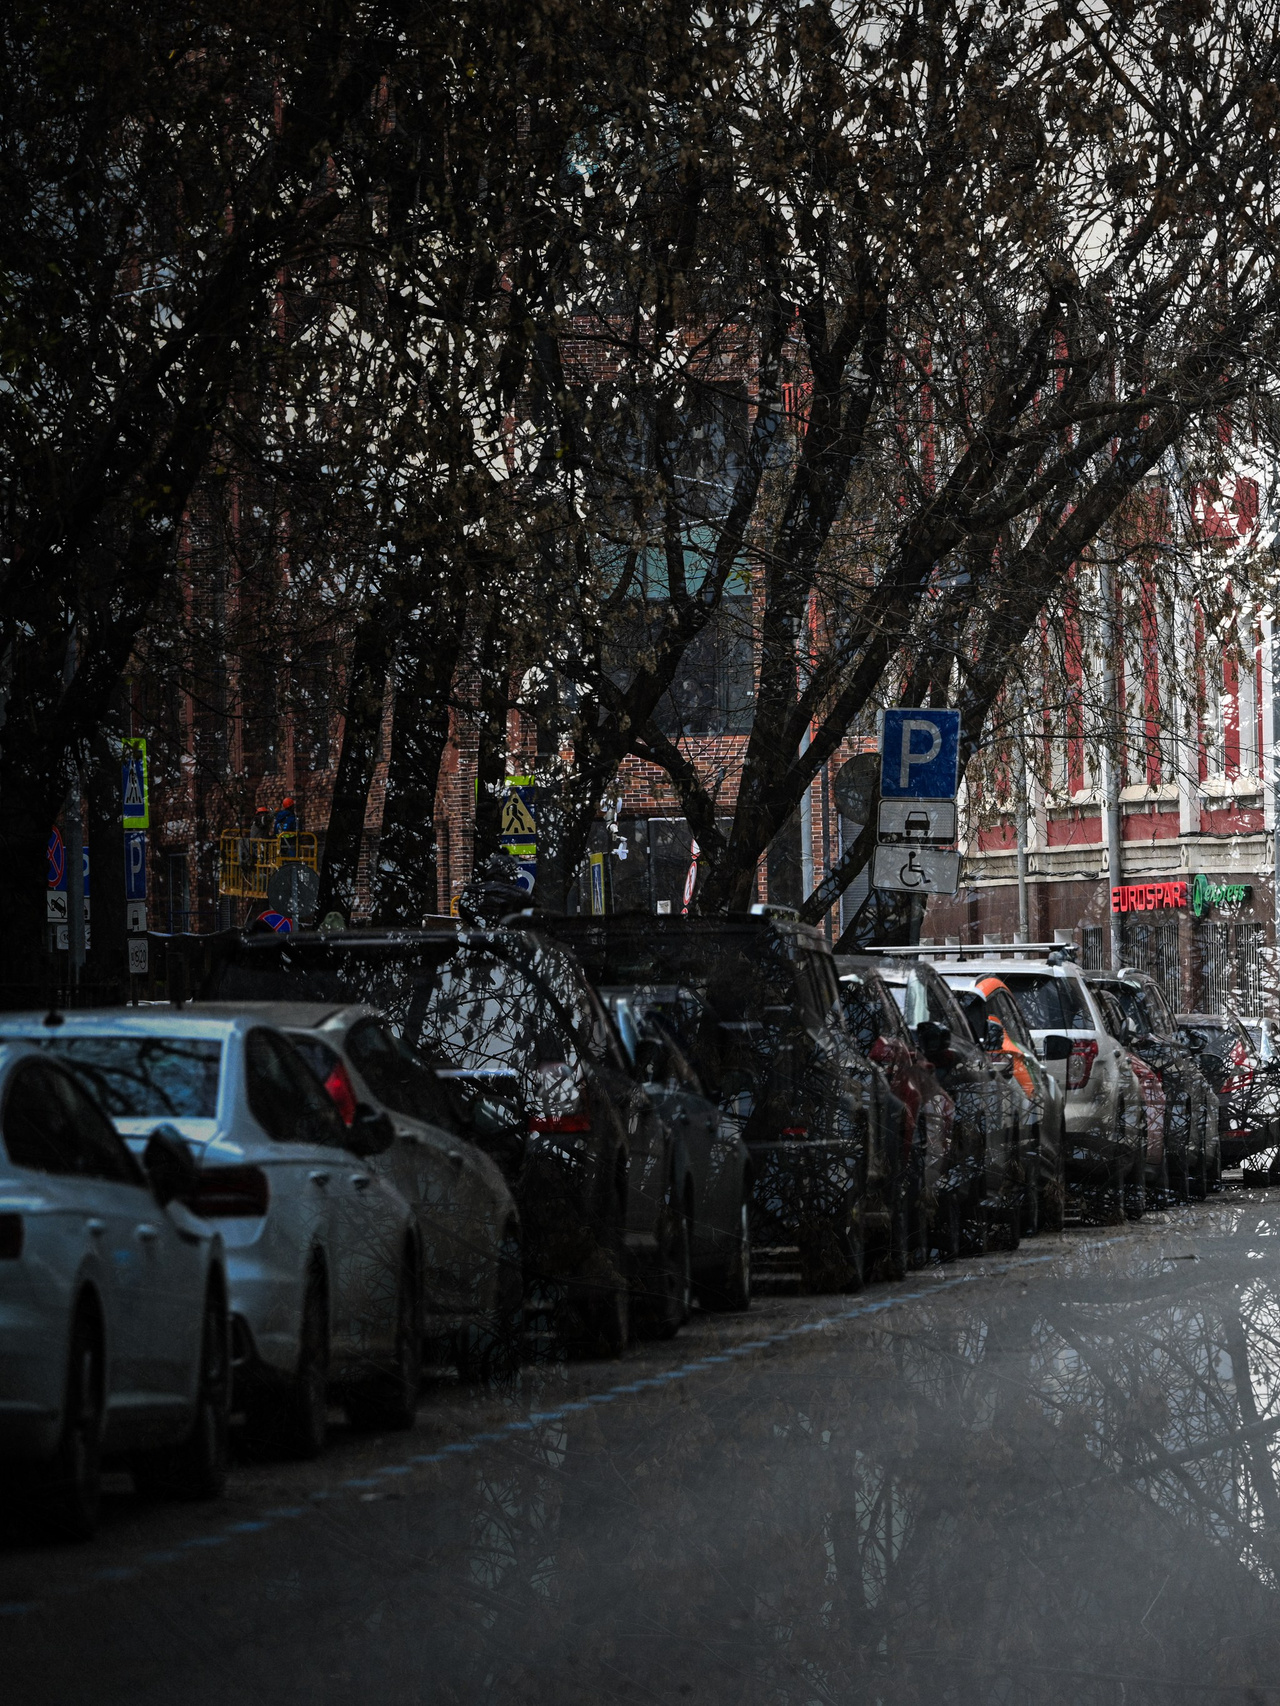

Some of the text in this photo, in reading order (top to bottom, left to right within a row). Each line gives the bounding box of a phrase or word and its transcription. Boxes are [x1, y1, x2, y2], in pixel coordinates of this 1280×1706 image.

[899, 719, 943, 788] P
[130, 840, 142, 892] P
[1111, 881, 1248, 913] EUROSPAR express
